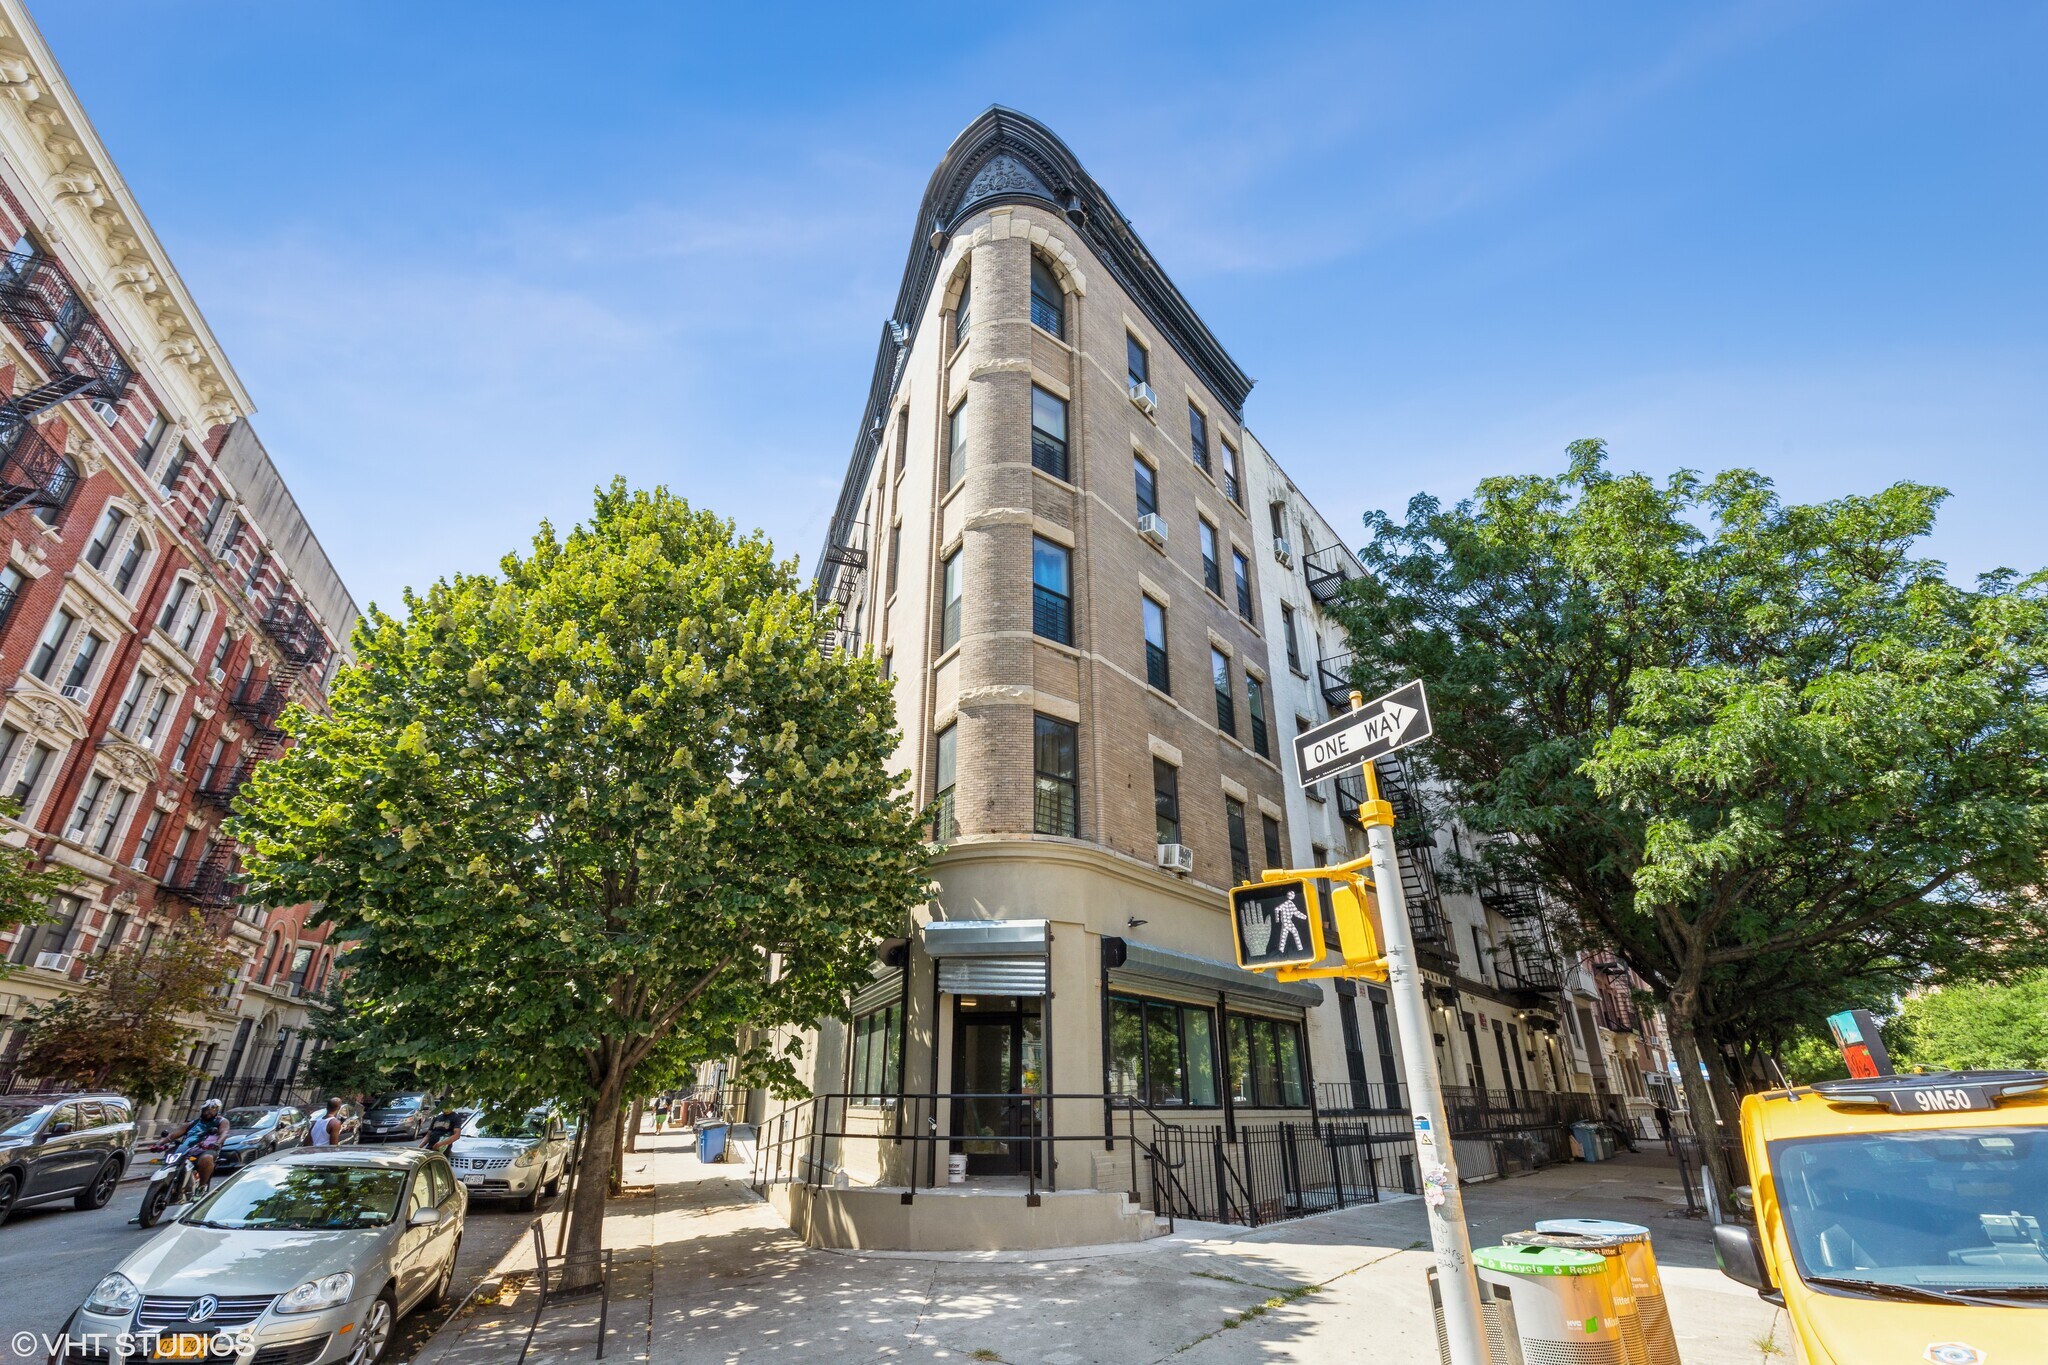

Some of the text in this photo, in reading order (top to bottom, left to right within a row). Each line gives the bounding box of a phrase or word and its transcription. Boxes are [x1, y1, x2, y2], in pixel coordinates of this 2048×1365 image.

[1314, 708, 1402, 763] ONE WAY
[1914, 1089, 1972, 1111] 9M50
[1500, 1261, 1544, 1274] Recycle
[1569, 1264, 1603, 1274] Recycle
